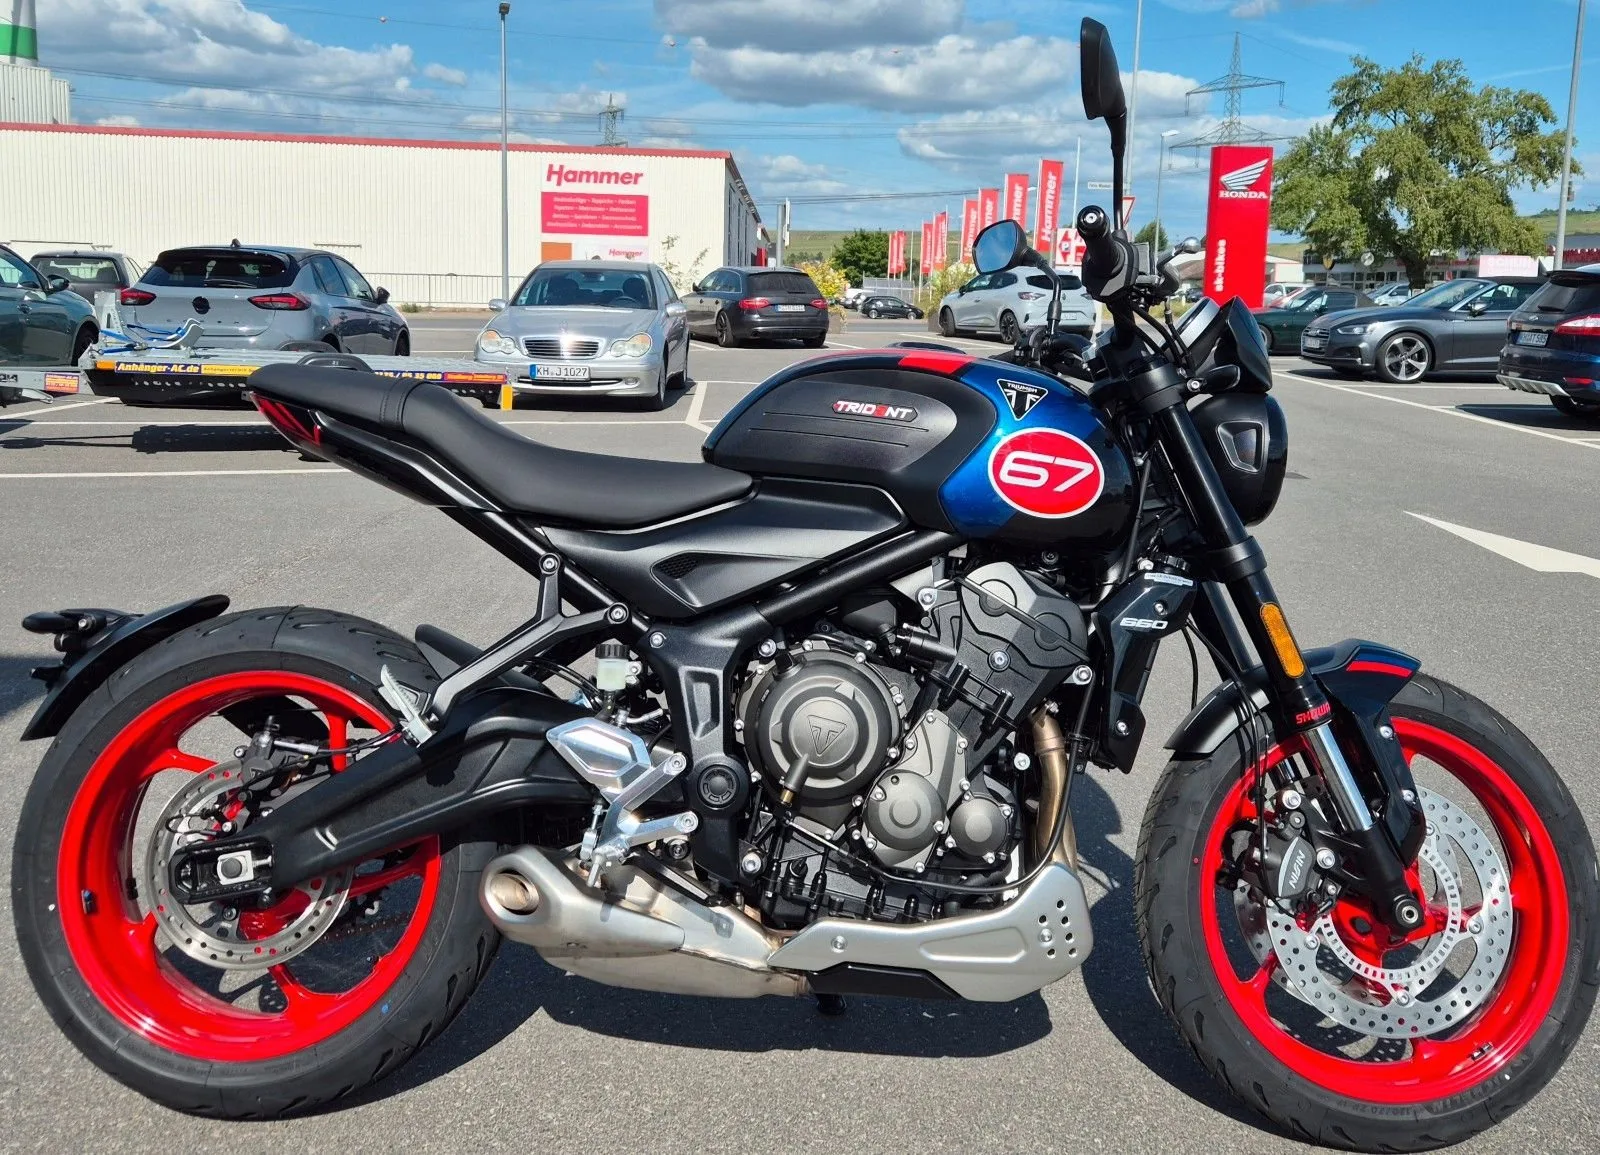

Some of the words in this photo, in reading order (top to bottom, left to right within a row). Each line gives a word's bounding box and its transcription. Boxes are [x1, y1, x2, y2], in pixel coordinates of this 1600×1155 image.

[546, 163, 644, 186] Hammer
[1218, 190, 1268, 199] HONDA
[1041, 171, 1057, 242] Hammer
[608, 248, 643, 258] Hammer
[1213, 239, 1226, 292] sk-bikes
[536, 366, 549, 376] KH
[563, 367, 588, 377] 1027
[1007, 382, 1037, 393] TRIUMPH
[835, 400, 913, 419] TRIDENT
[1000, 450, 1094, 492] 67
[1120, 618, 1168, 630] 660
